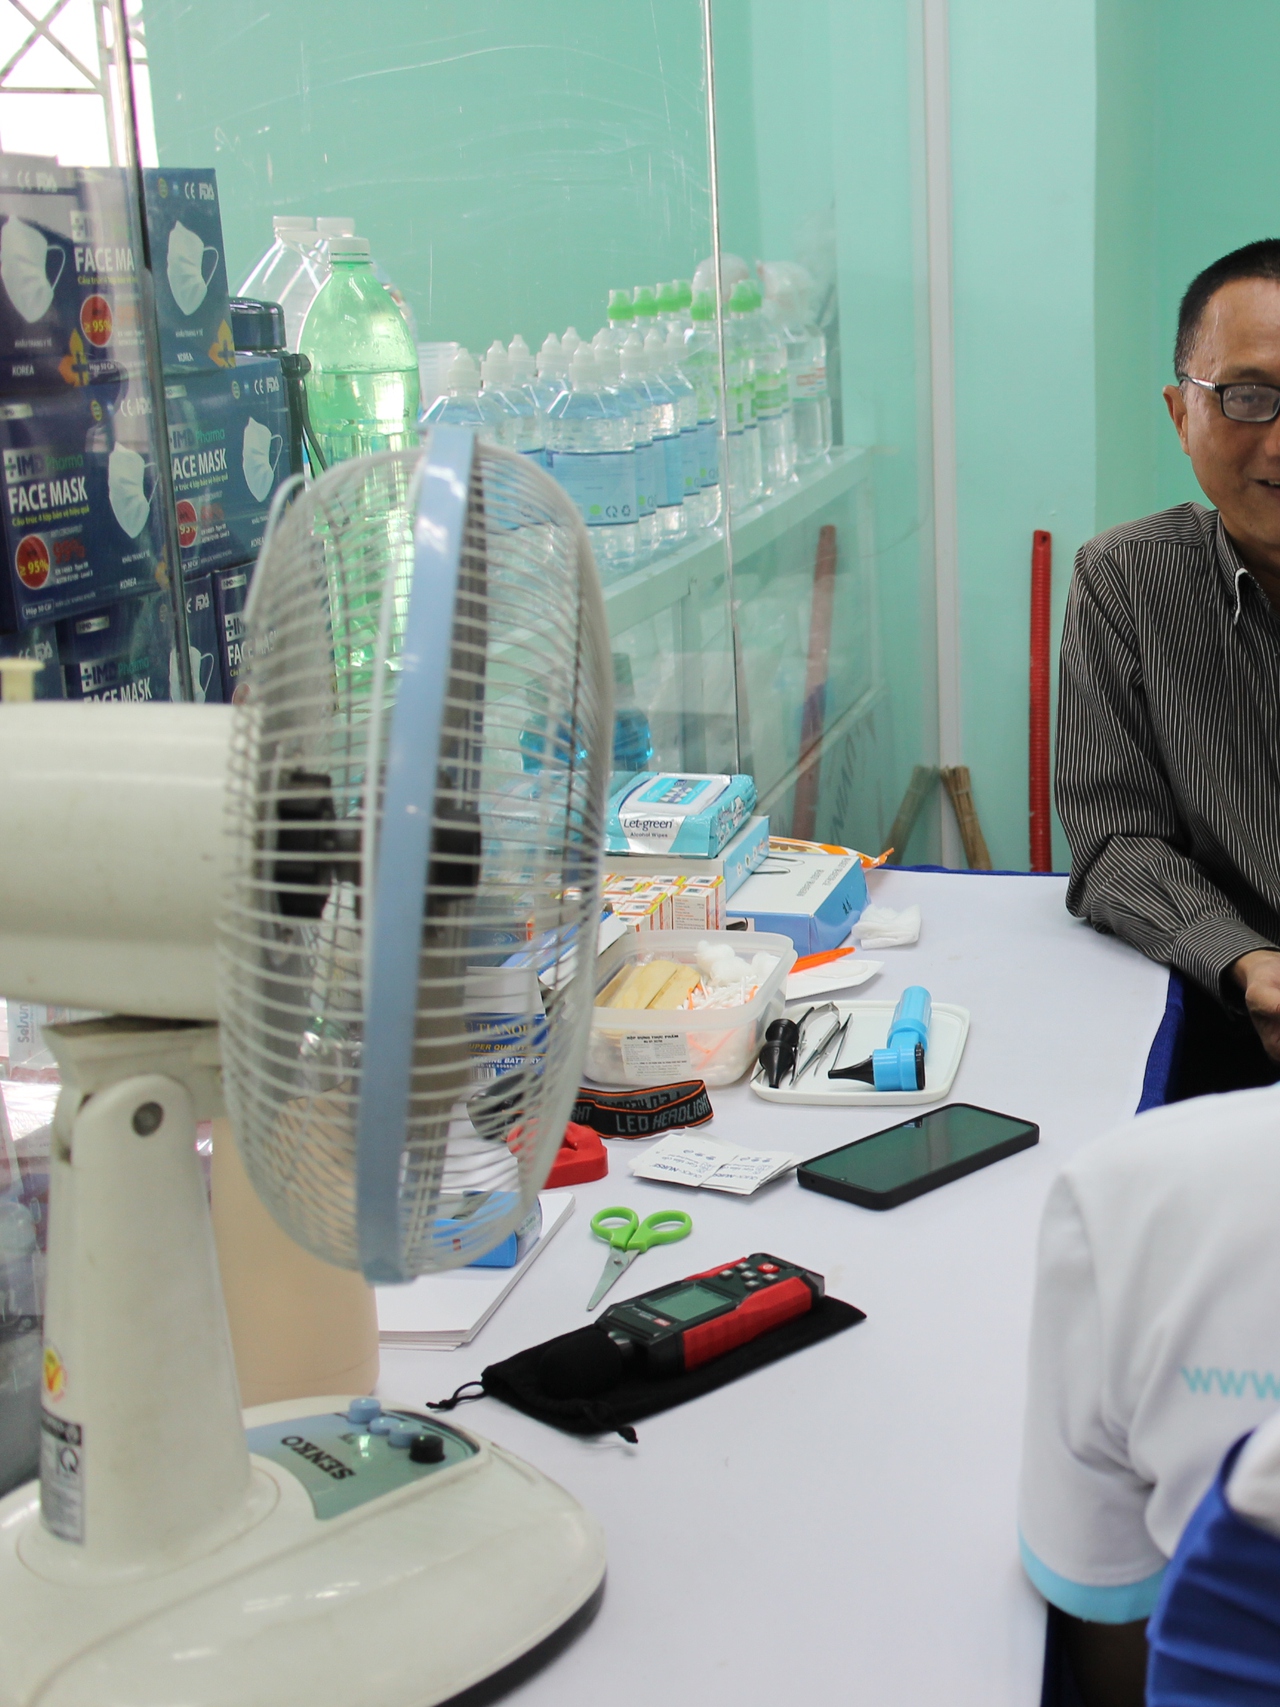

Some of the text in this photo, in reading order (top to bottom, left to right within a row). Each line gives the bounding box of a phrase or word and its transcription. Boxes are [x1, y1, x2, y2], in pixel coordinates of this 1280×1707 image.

[74, 247, 135, 273] FACE MA
[12, 364, 34, 377] KOREA
[173, 448, 228, 481] ACE MASK
[8, 475, 88, 515] FACE MASK
[28, 558, 49, 574] 95%
[120, 577, 137, 590] KOREA
[623, 818, 673, 831] Let-green
[17, 1003, 30, 1043] Selsun
[615, 1113, 649, 1133] LED
[281, 1435, 356, 1480] SENKO
